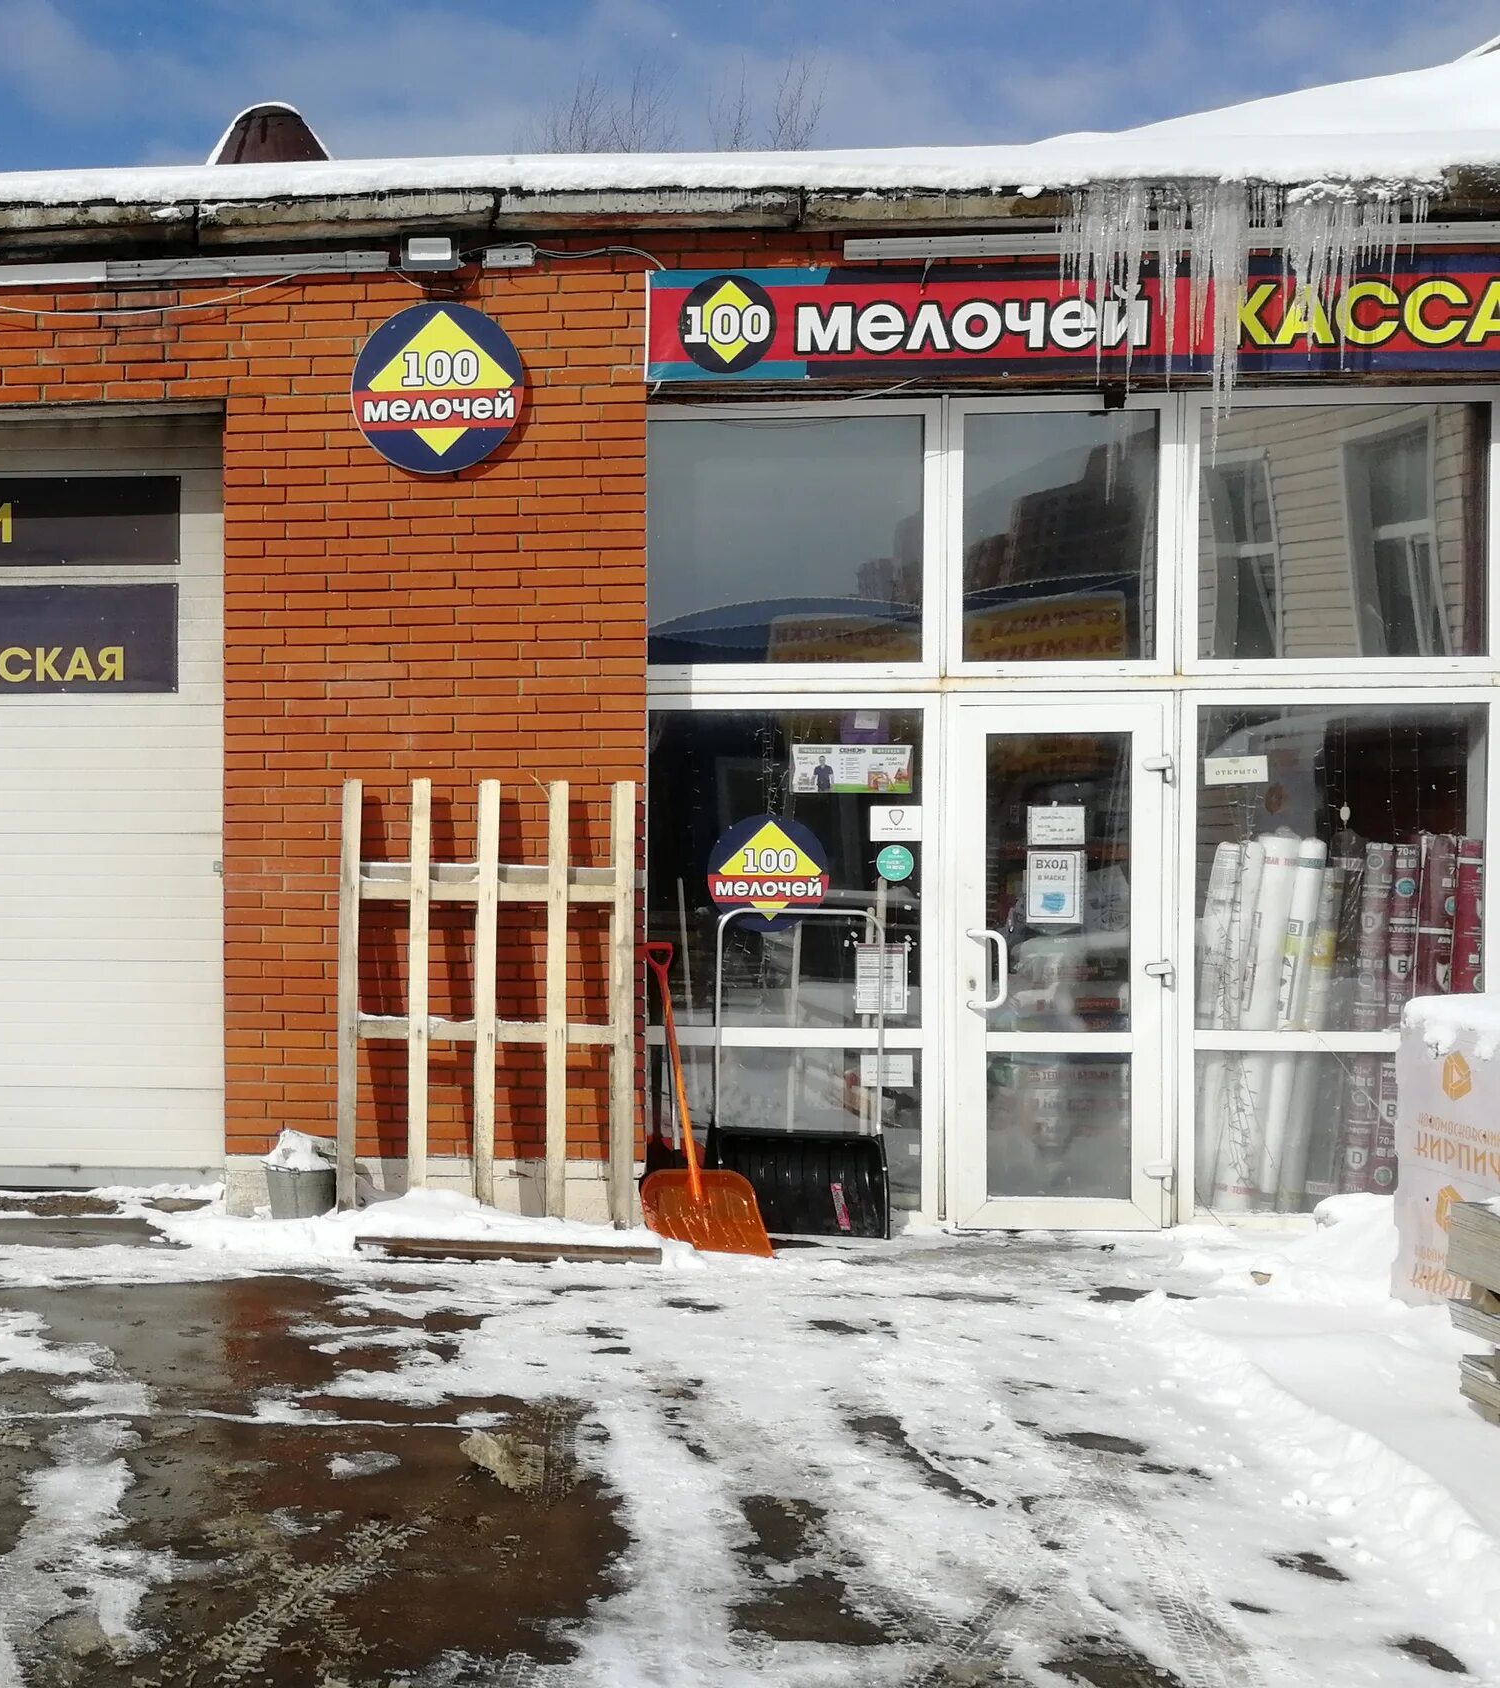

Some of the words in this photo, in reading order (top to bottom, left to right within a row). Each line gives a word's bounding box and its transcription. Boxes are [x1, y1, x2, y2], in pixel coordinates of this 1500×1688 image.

[683, 303, 770, 345] 100
[797, 284, 1149, 353] мелочей
[401, 351, 478, 386] 100
[363, 390, 514, 422] мелочей
[1214, 768, 1259, 776] ОТКРЫТО
[743, 848, 797, 873] 100
[1035, 859, 1068, 871] ВХОД
[715, 877, 822, 897] мелочей
